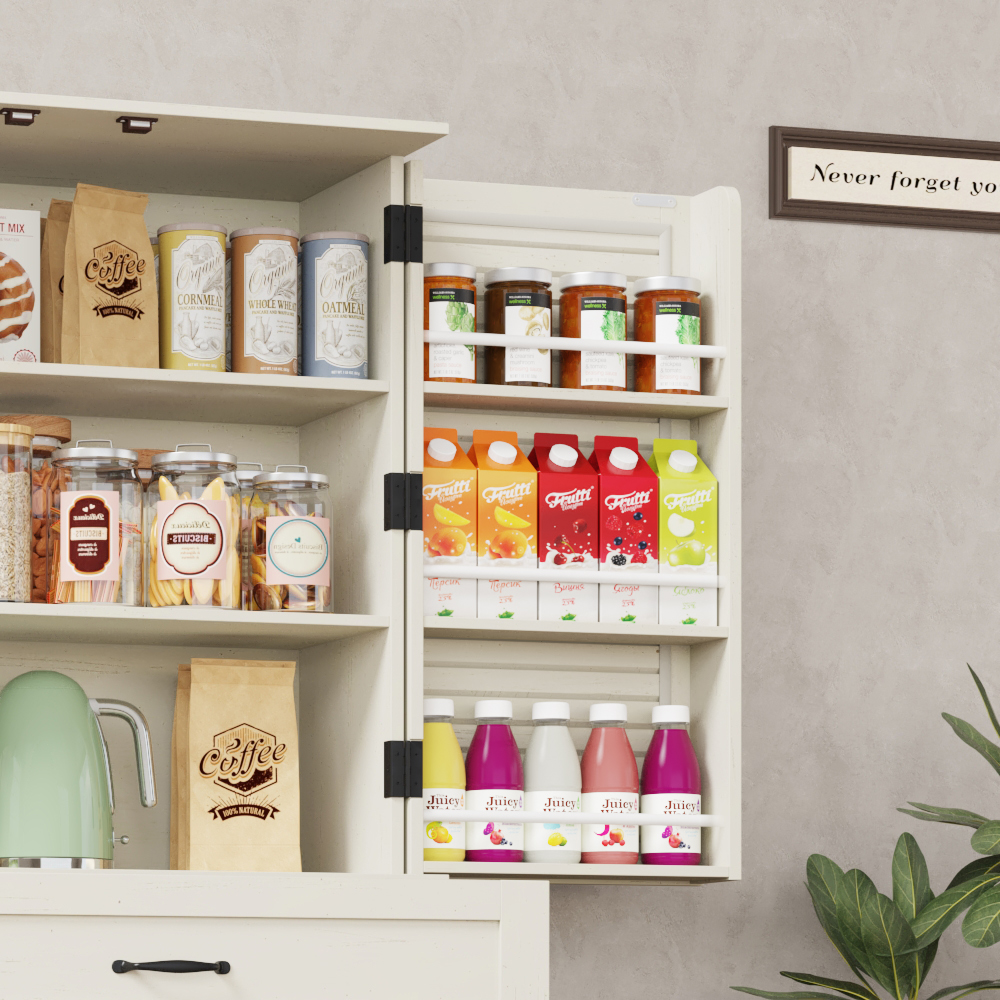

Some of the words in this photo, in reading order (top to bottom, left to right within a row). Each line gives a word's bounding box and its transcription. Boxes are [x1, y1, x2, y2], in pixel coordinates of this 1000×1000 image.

[809, 162, 881, 185] Never
[890, 171, 962, 193] forget
[970, 180, 1000, 196] yo
[8, 223, 25, 233] MIX
[85, 253, 147, 284] Coffee
[177, 293, 223, 307] CORNMEAL
[248, 299, 276, 310] WHOLE
[114, 307, 134, 317] NATURAL
[322, 301, 365, 315] OATMEAL
[422, 479, 472, 501] Frutti
[482, 481, 532, 504] Frutti
[545, 487, 593, 509] Frutti
[604, 490, 651, 511] Frutti
[663, 489, 712, 511] Frutti
[199, 738, 287, 779] Coffee
[427, 795, 460, 808] Juicy
[486, 796, 519, 809] Juicy
[544, 797, 577, 810] Juicy
[602, 798, 634, 811] Juicy
[665, 800, 697, 813] Juicy
[222, 807, 238, 817] 100%
[238, 806, 265, 817] NATURAL
